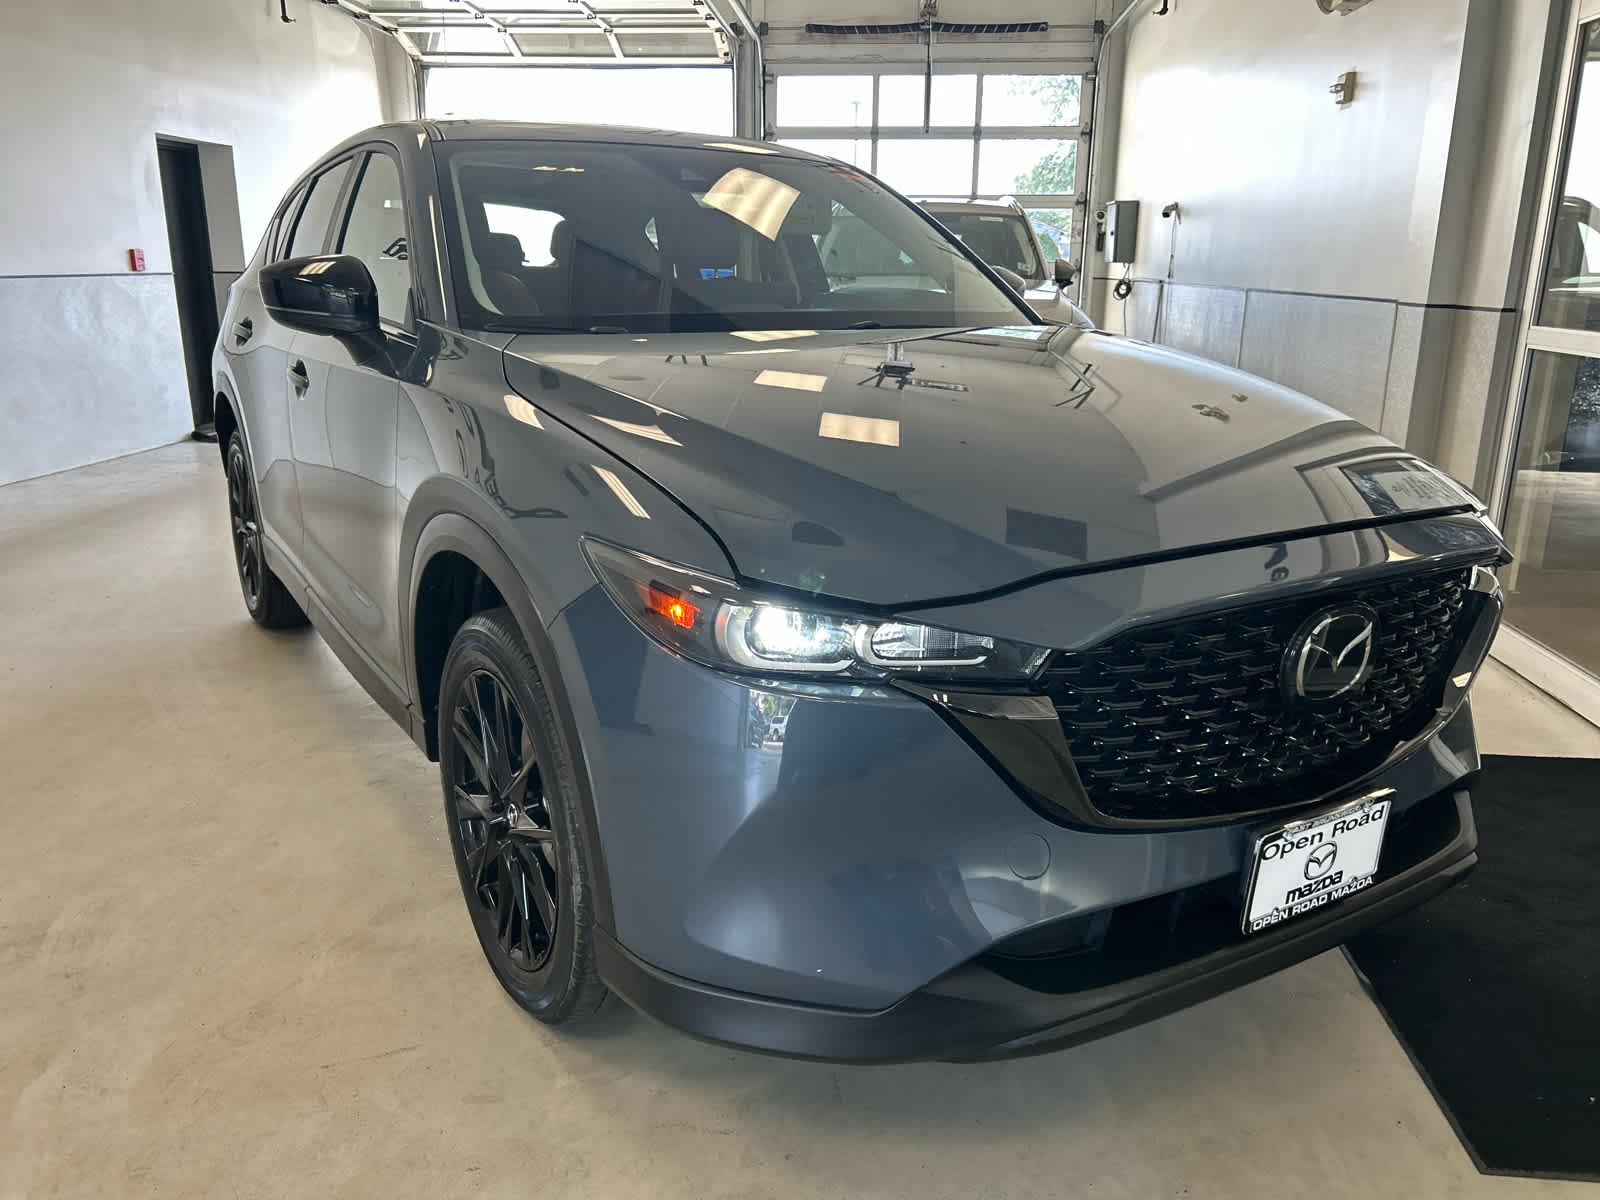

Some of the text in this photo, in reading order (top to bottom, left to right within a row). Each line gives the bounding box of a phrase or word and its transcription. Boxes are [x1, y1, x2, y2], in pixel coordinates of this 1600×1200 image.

[1262, 832, 1323, 860] Open
[1332, 805, 1385, 837] Road
[1253, 876, 1373, 931] OPEN ROAD MAZDA
[1285, 870, 1343, 905] mazda
